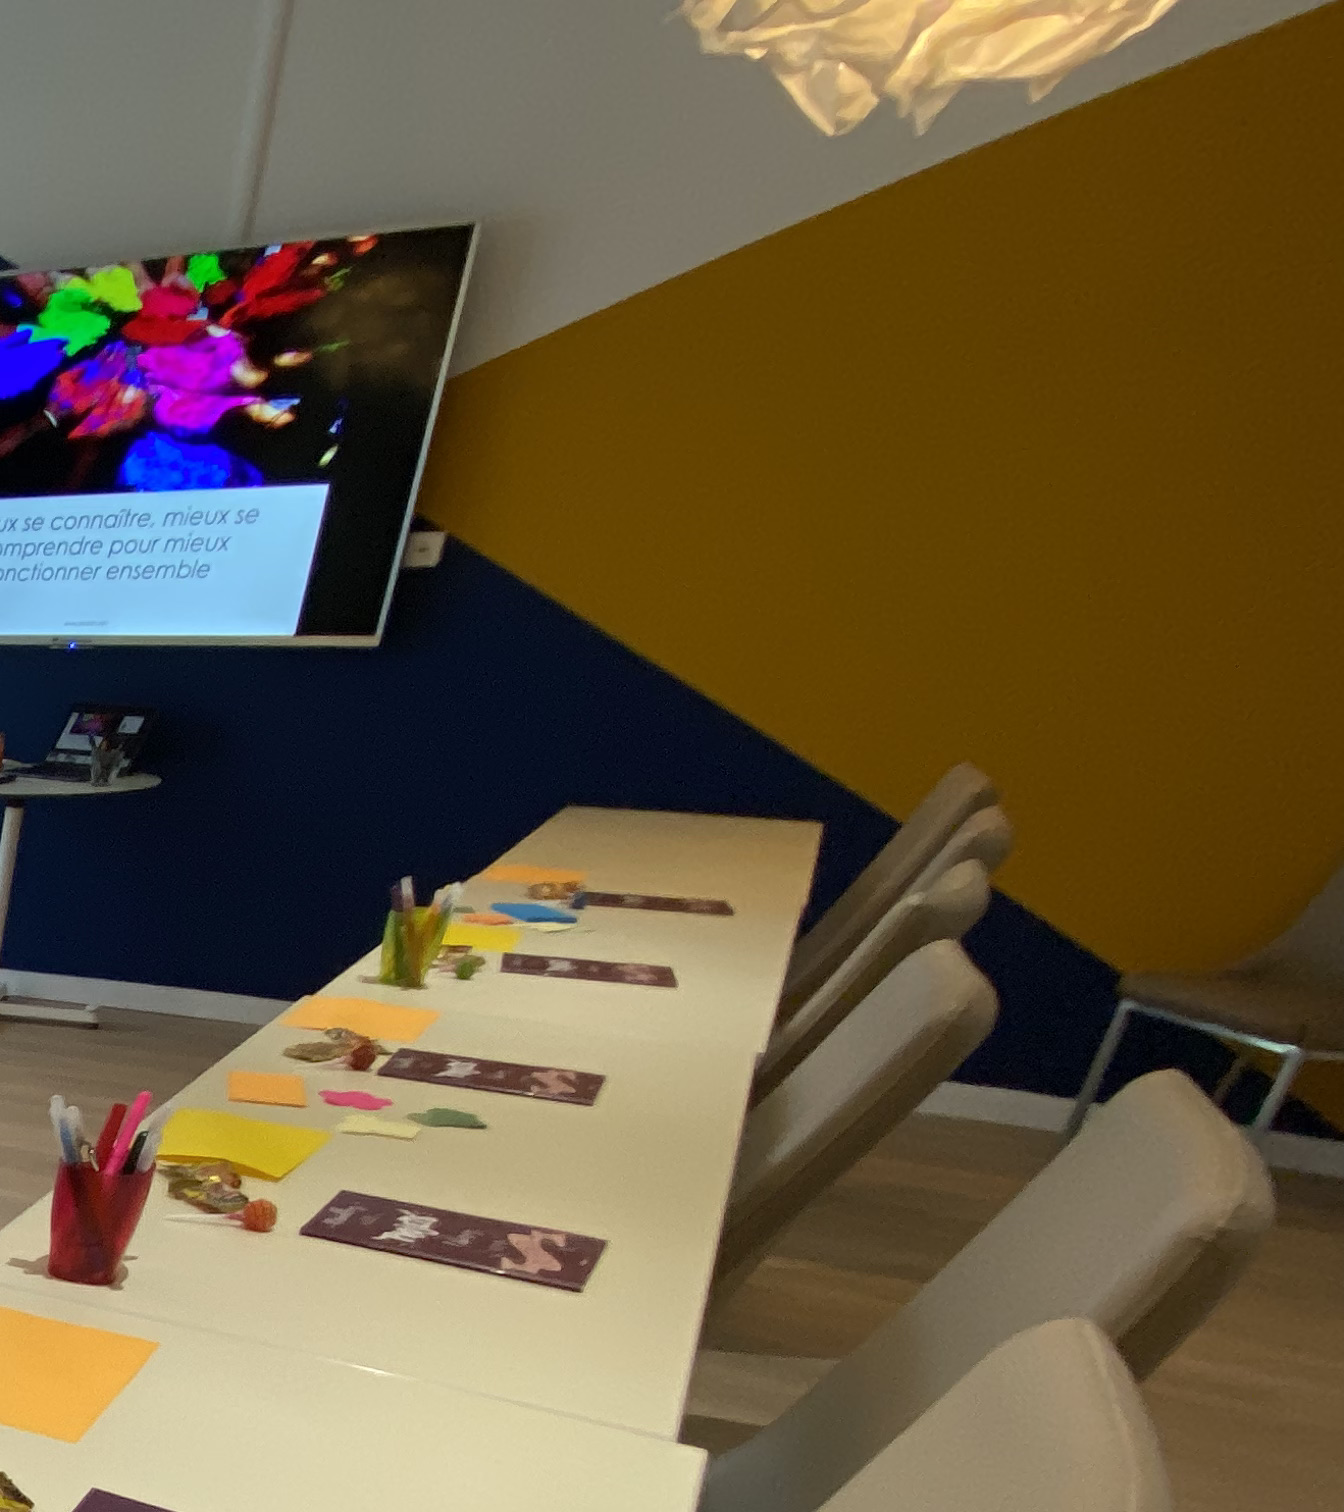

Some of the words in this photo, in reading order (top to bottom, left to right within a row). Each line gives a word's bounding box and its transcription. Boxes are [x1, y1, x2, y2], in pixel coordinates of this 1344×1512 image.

[21, 517, 45, 532] se
[50, 508, 156, 531] connaître,
[162, 506, 228, 528] mieux
[233, 507, 260, 526] se
[107, 539, 161, 558] pour
[163, 533, 232, 553] mieux
[106, 559, 211, 581] ensemble
